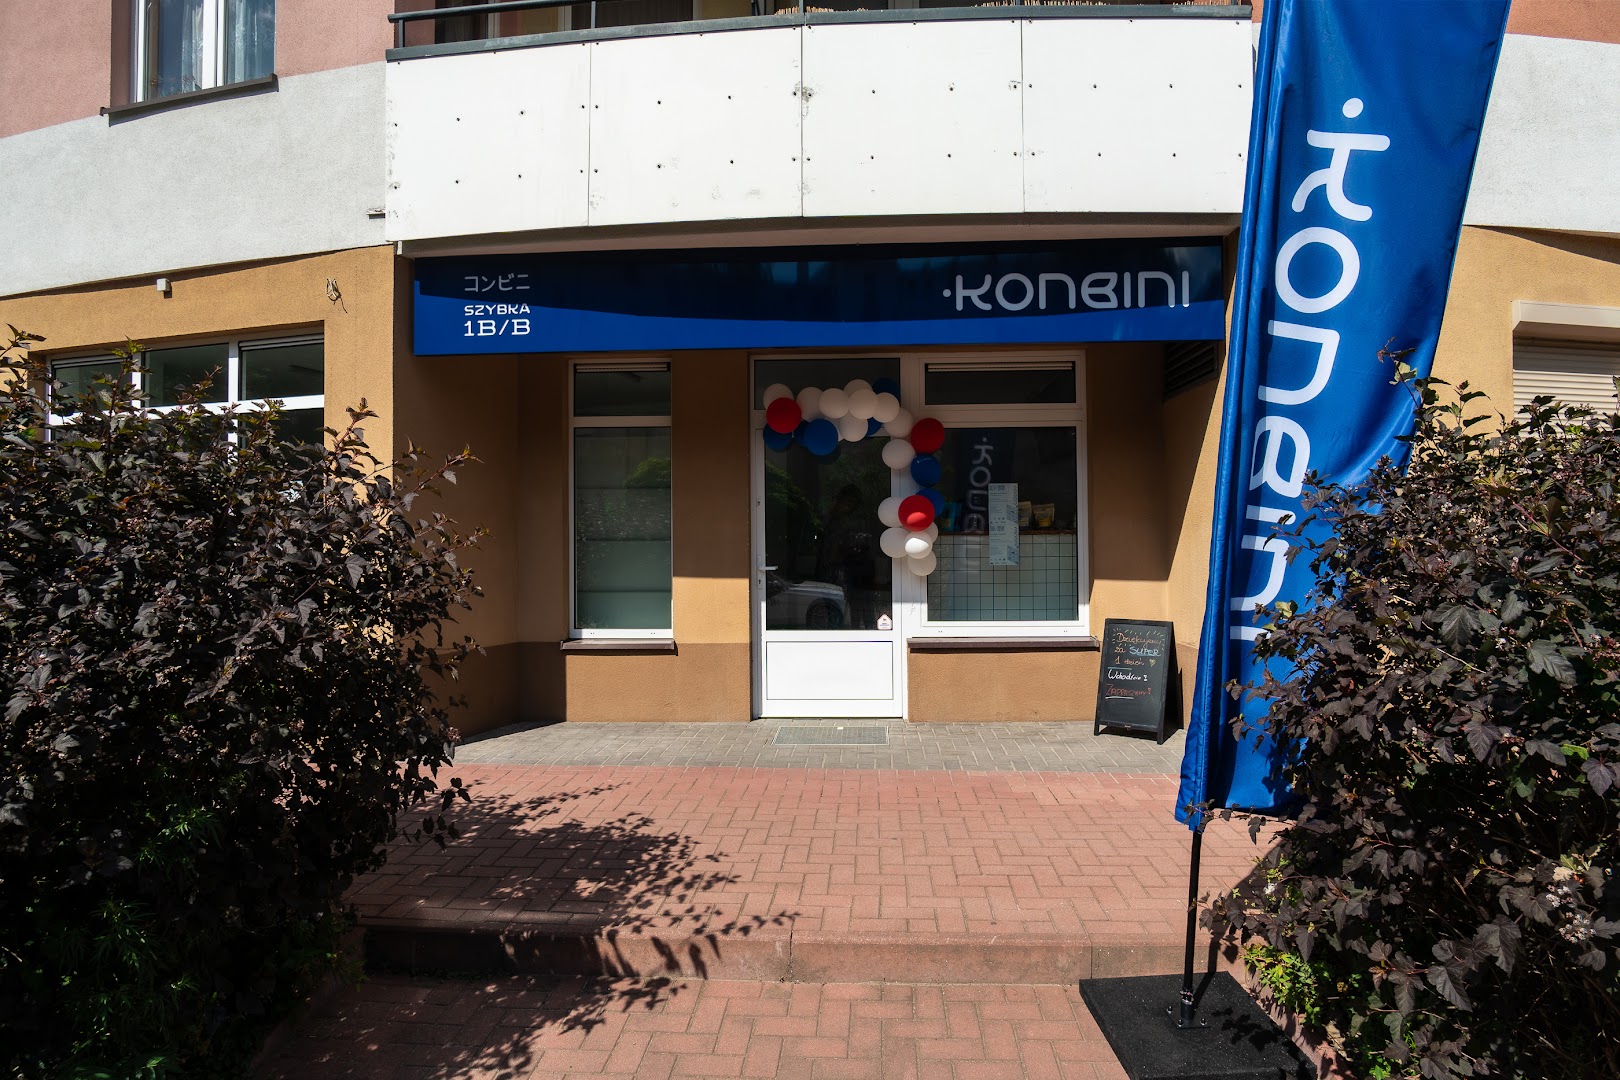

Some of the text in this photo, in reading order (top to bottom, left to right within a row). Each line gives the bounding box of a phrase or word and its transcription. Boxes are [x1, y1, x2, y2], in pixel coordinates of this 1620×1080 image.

[464, 273, 530, 292] コンビニ
[942, 270, 1190, 311] KONBINI
[464, 303, 531, 316] SZYBKA
[464, 318, 531, 337] 1B/B
[1129, 646, 1161, 656] SUPER
[1115, 656, 1121, 665] 1
